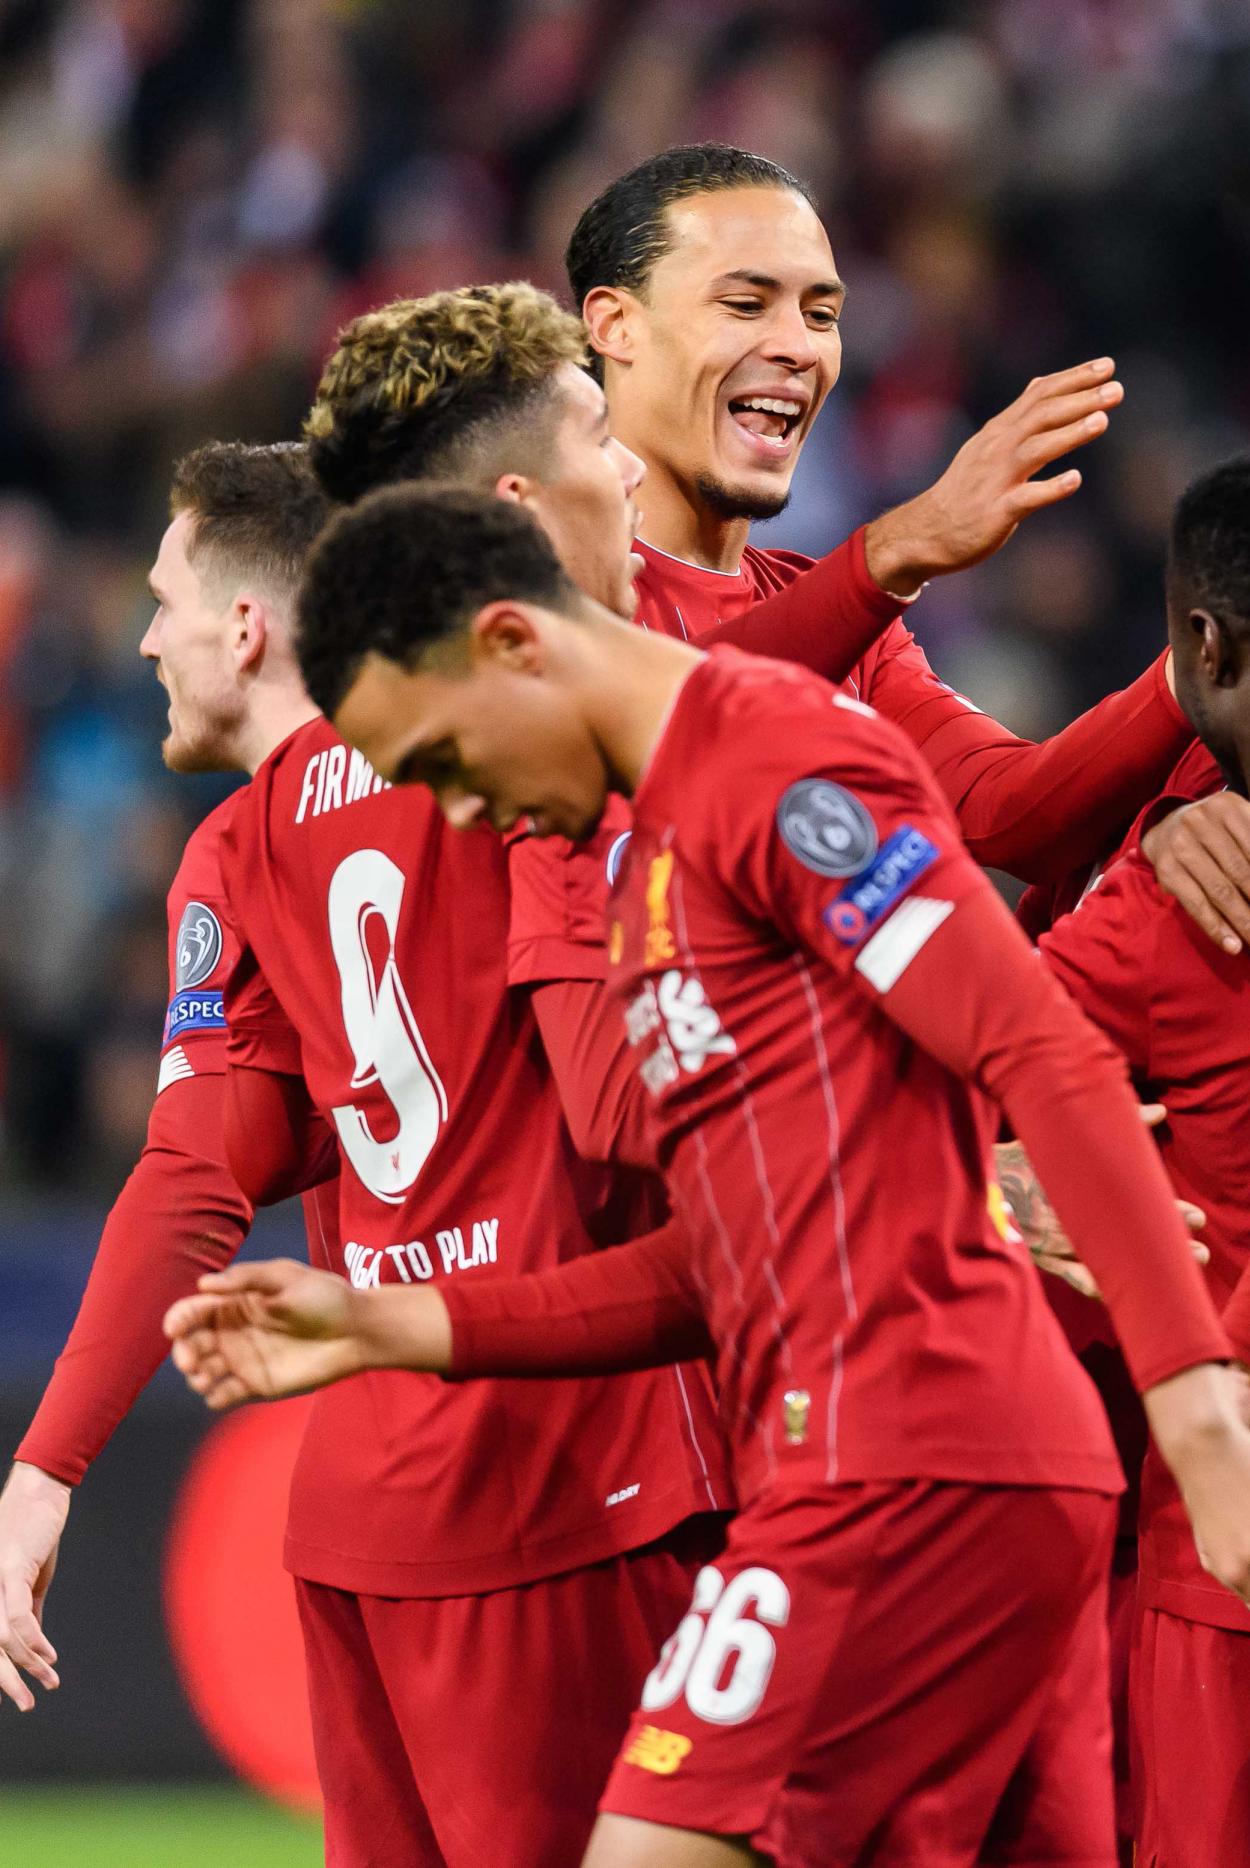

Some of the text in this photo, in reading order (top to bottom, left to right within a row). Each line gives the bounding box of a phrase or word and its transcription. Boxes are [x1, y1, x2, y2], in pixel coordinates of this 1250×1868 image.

[295, 744, 393, 824] FIRM
[170, 1001, 225, 1028] RESPEC
[328, 848, 448, 1204] 9
[385, 1241, 434, 1284] TO
[435, 1218, 499, 1275] PLAY
